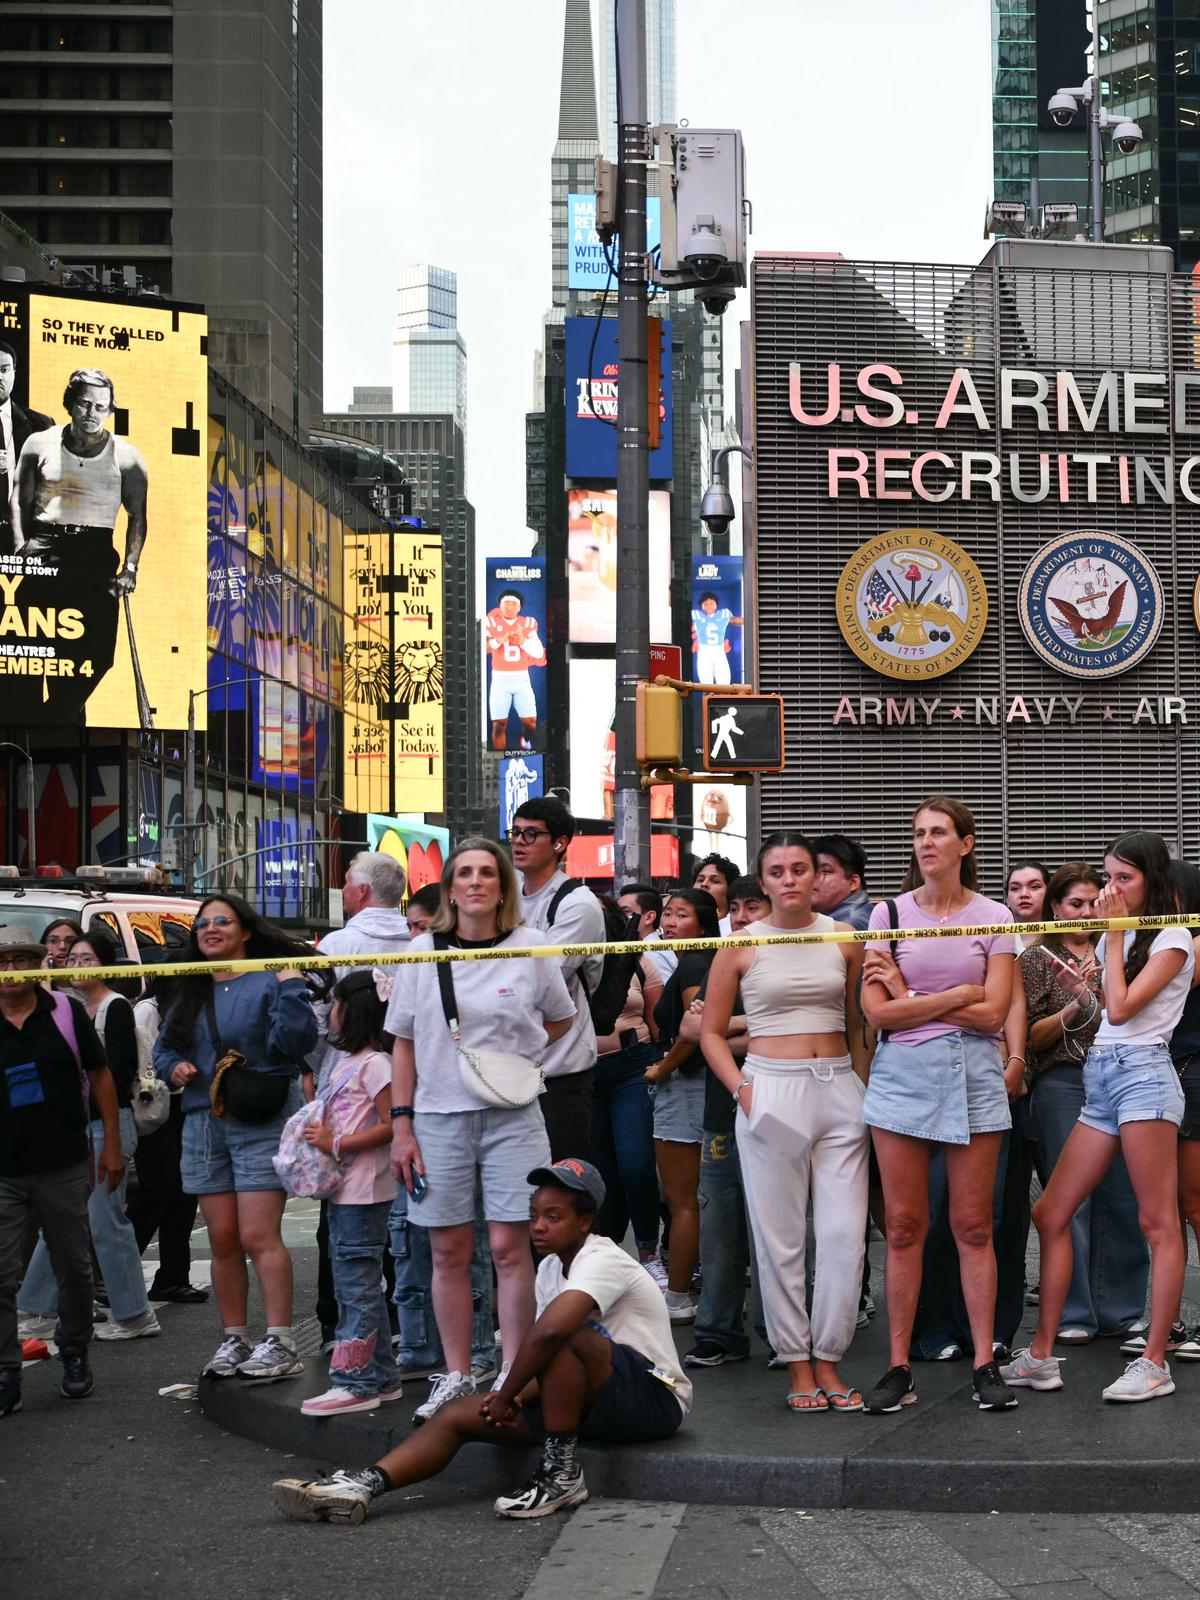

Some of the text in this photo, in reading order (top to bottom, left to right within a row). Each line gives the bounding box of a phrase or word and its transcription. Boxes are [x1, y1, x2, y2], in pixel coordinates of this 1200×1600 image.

[4, 315, 22, 330] IT.
[42, 318, 63, 330] SO
[67, 320, 105, 335] THEY
[42, 331, 57, 343] IN
[62, 333, 89, 347] THE
[788, 362, 919, 427] U.S.
[412, 545, 424, 560] It
[26, 556, 42, 566] ON
[25, 565, 59, 577] STORY
[495, 568, 542, 579] CHAMBLISS
[845, 535, 912, 592] DEPARTMENT
[919, 536, 936, 548] OF
[941, 543, 964, 566] THE
[961, 567, 982, 606] ARMY
[1032, 544, 1149, 601] DEPARTMENT OF THE NAVY
[411, 581, 424, 597] in
[402, 599, 429, 616] You
[706, 623, 719, 645] 5
[843, 605, 981, 673] UNITED STATES OF AMERICA
[1032, 609, 1151, 666] UNITED STATES OF AMERICA
[503, 641, 521, 662] 6
[897, 646, 926, 656] 1775
[79, 659, 95, 678] 4
[832, 697, 941, 726] ARMY
[975, 695, 1084, 726] NAVY
[1132, 697, 1188, 725] AIR
[400, 723, 435, 737] See it
[398, 738, 439, 755] Today.
[1138, 915, 1159, 926] CROSS
[1164, 914, 1178, 925] NOT
[1179, 914, 1190, 925] DO
[914, 929, 937, 939] SCENE
[939, 928, 963, 938] CRIME
[991, 923, 1047, 935] 1-800-577-TIPS
